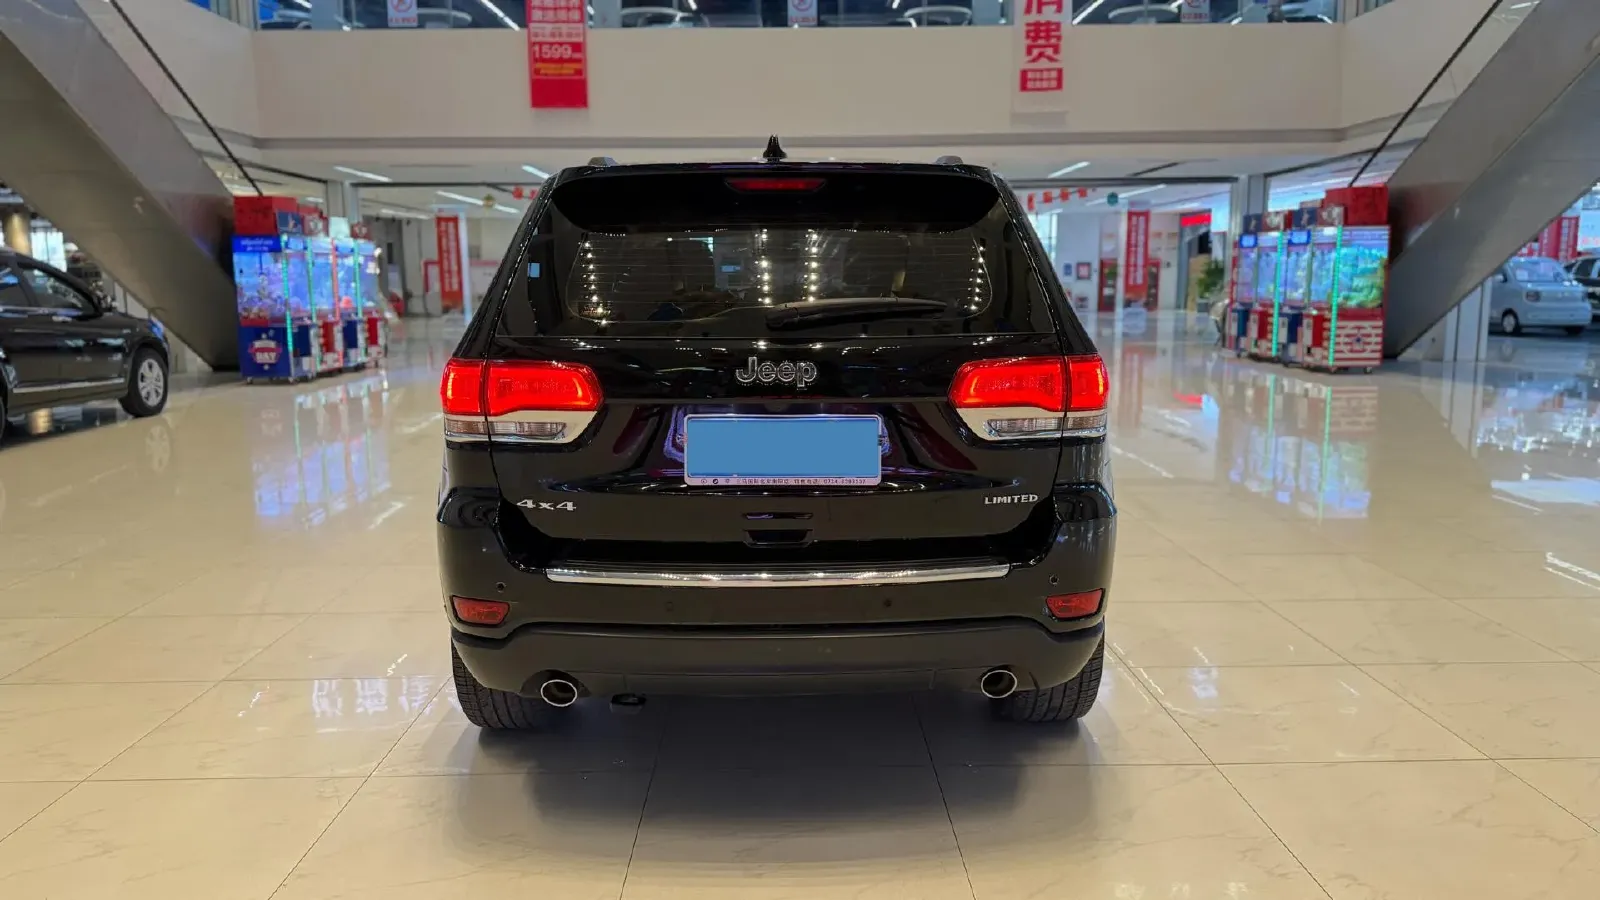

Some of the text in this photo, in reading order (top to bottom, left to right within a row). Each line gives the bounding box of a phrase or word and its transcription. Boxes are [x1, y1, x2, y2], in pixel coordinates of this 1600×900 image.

[533, 43, 572, 59] 1599
[736, 356, 817, 387] Jeep
[516, 499, 577, 511] 4x4
[984, 494, 1039, 505] LIMITED
